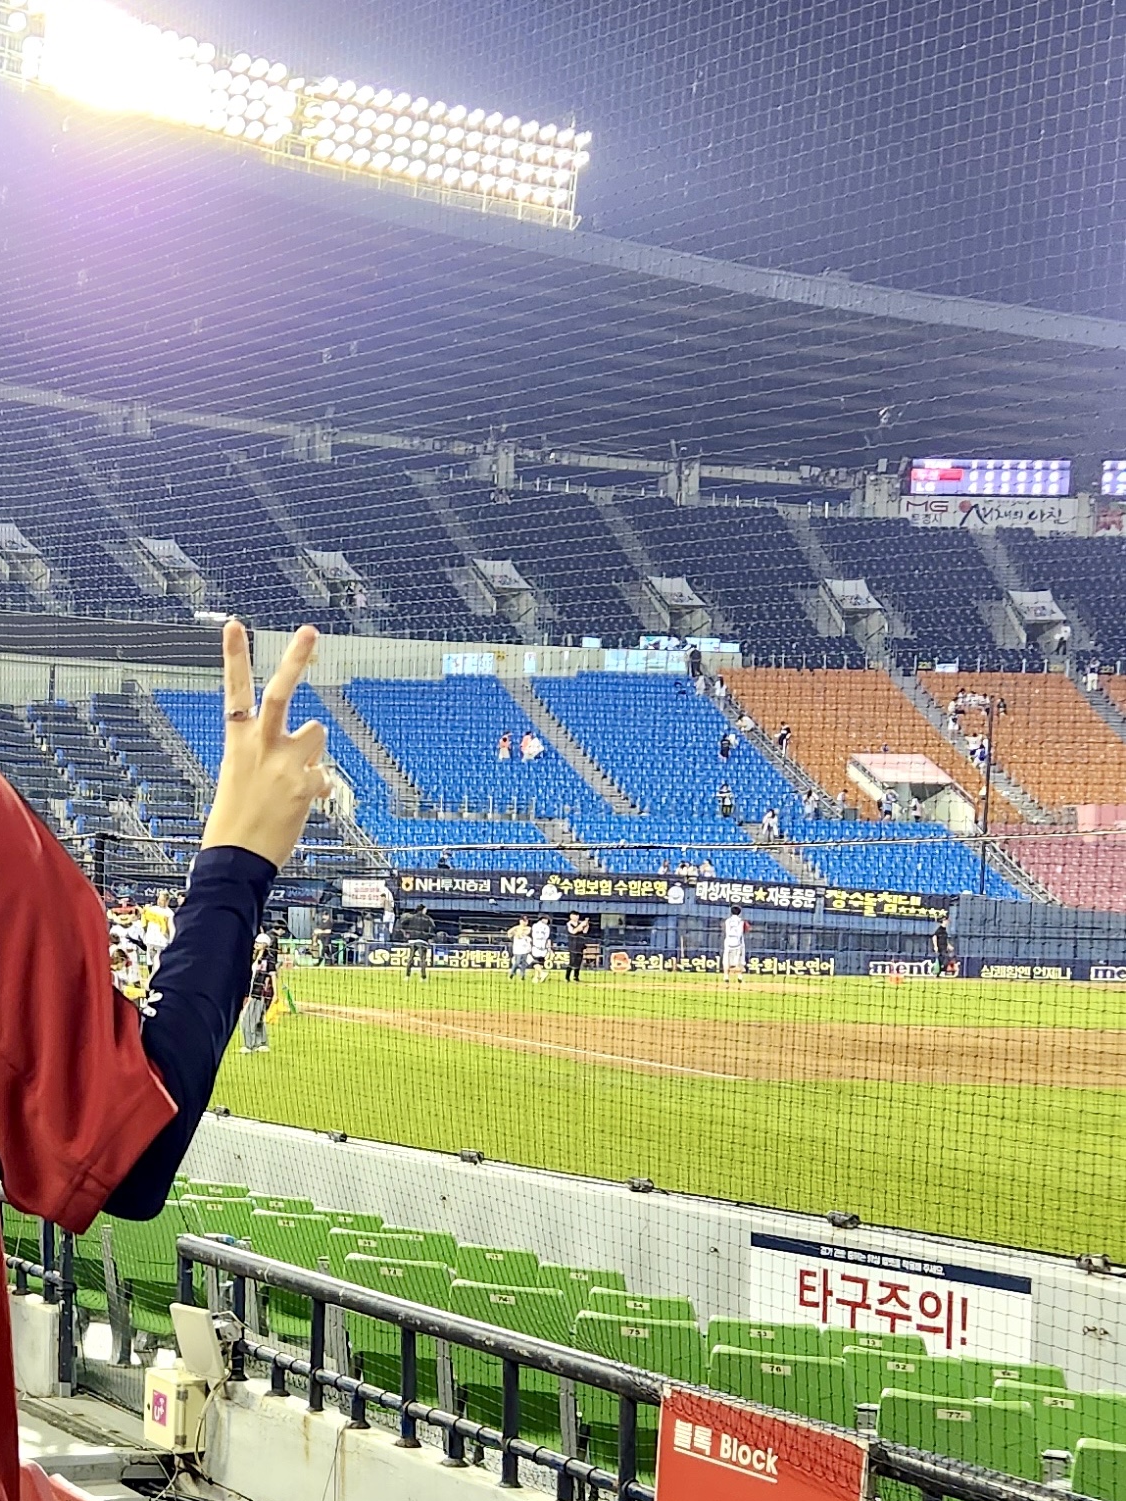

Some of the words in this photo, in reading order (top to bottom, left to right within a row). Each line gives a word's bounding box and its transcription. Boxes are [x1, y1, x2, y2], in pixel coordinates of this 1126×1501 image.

[915, 482, 936, 492] LG
[415, 877, 490, 892] NH투자증권
[501, 876, 535, 897] N2,
[614, 880, 667, 897] 수협은행
[870, 960, 961, 977] ment
[799, 1267, 969, 1350] 타구주의!
[674, 1418, 712, 1456] 블록
[720, 1433, 779, 1476] Block
